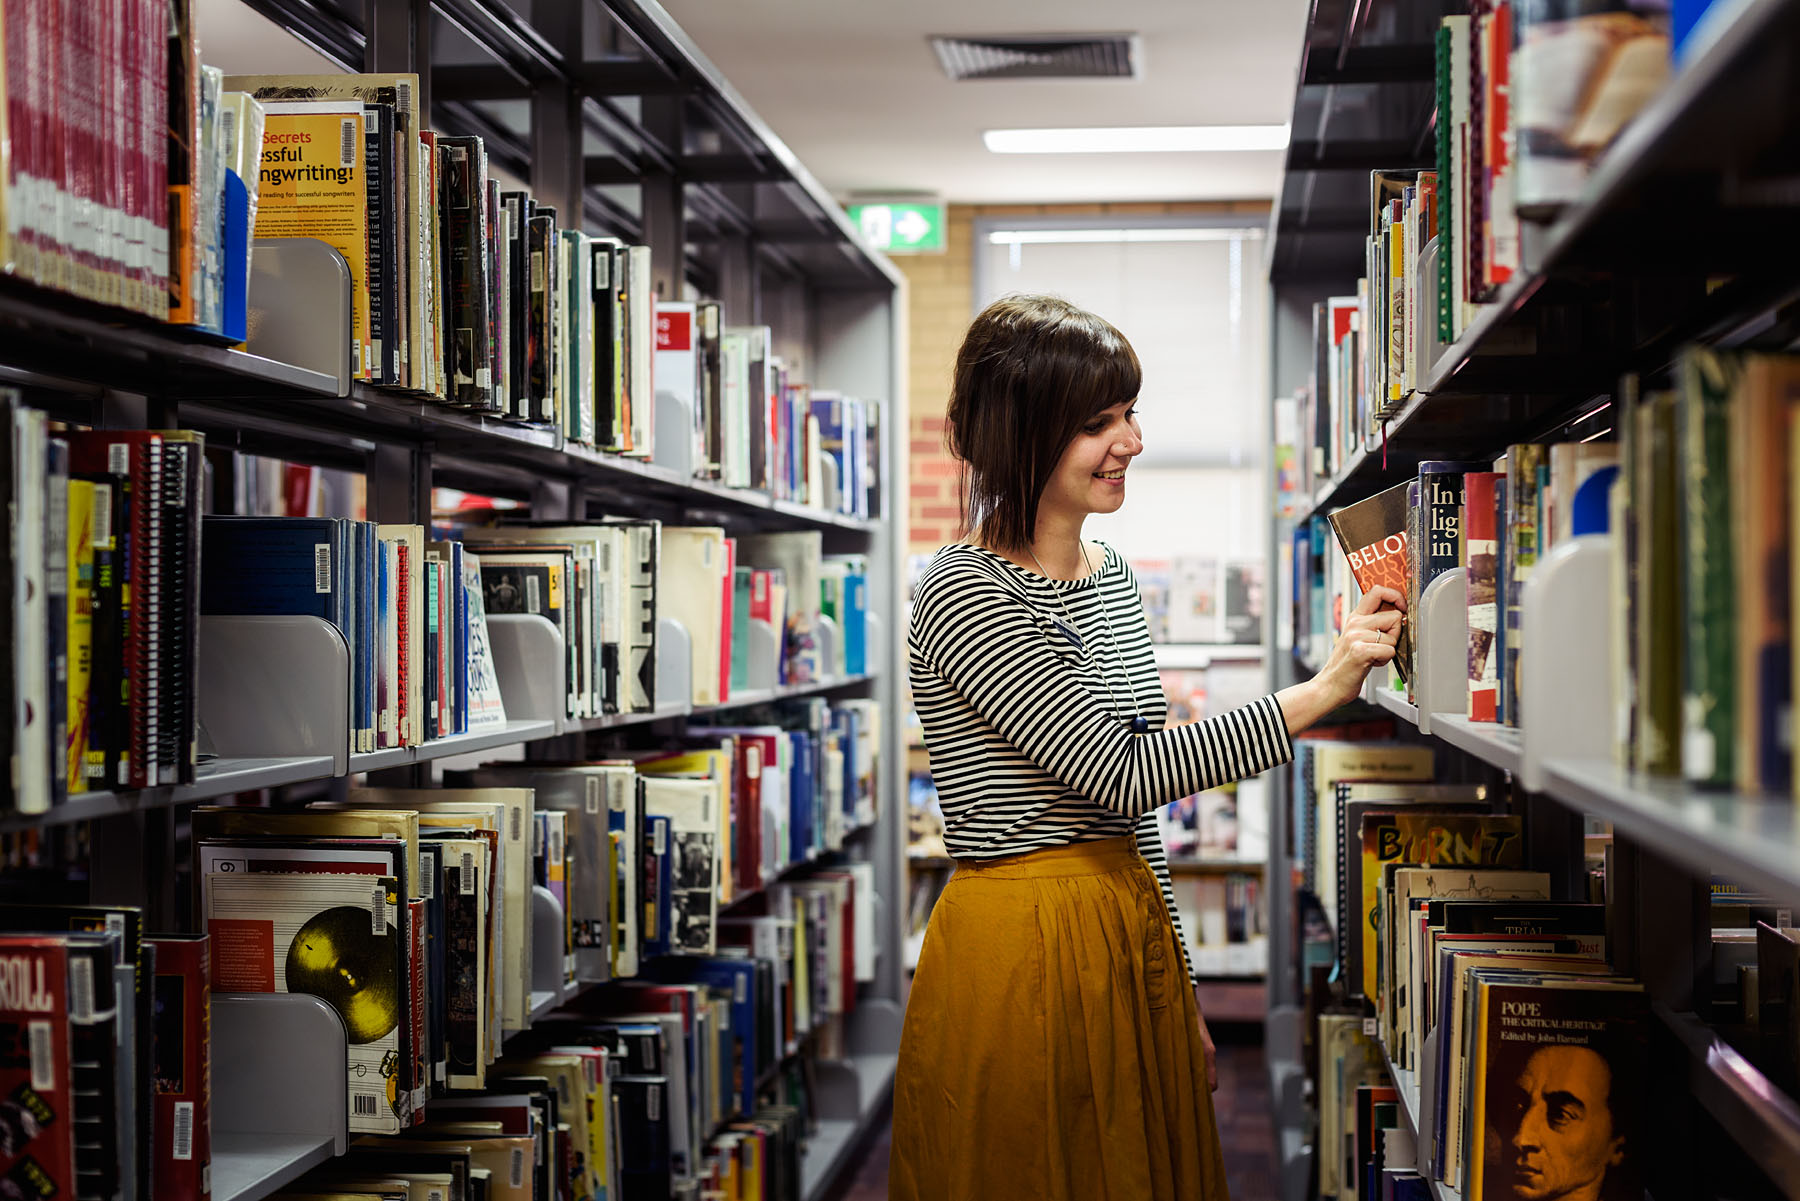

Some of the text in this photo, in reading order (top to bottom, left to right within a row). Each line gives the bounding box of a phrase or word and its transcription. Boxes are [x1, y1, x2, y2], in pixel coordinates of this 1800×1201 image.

[263, 131, 312, 144] Secrets
[323, 191, 356, 199] songwriters
[1431, 482, 1455, 505] In
[1431, 507, 1459, 539] lig
[1431, 534, 1454, 557] in
[1377, 825, 1519, 864] BURNT
[1501, 1001, 1541, 1017] POPE
[1502, 1017, 1607, 1032] THE CRITICAL HERITAGE
[1501, 1031, 1589, 1044] Edited by John Barnard
